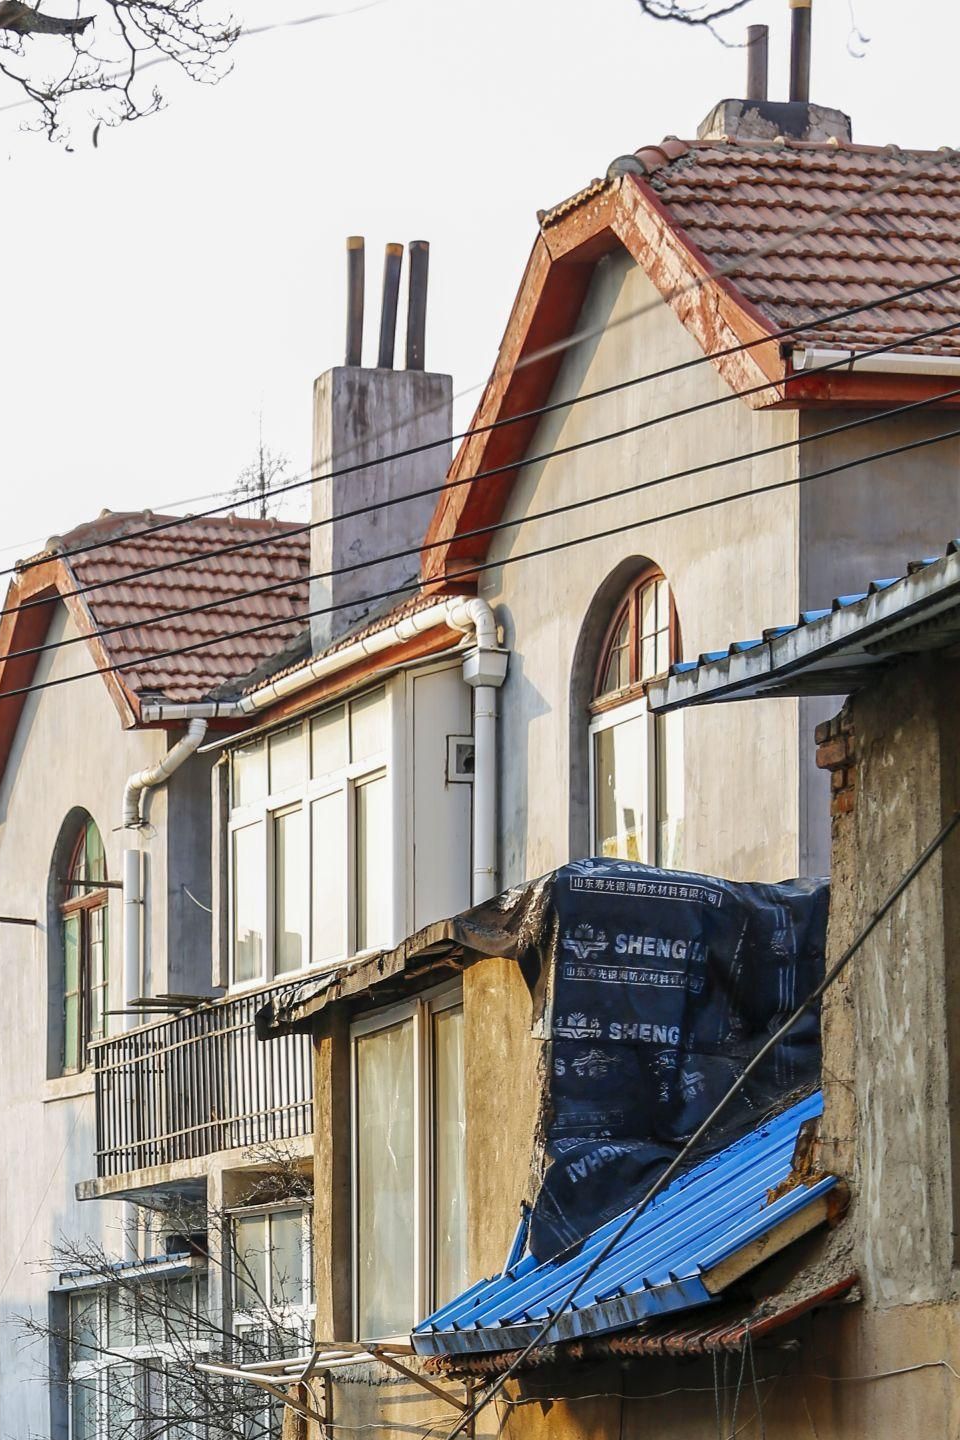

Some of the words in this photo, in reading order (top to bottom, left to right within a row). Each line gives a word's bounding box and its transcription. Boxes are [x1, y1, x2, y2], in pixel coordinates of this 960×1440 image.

[573, 877, 717, 905] 山东寿光银海防水材料有限公司
[609, 1022, 682, 1046] SHENG
